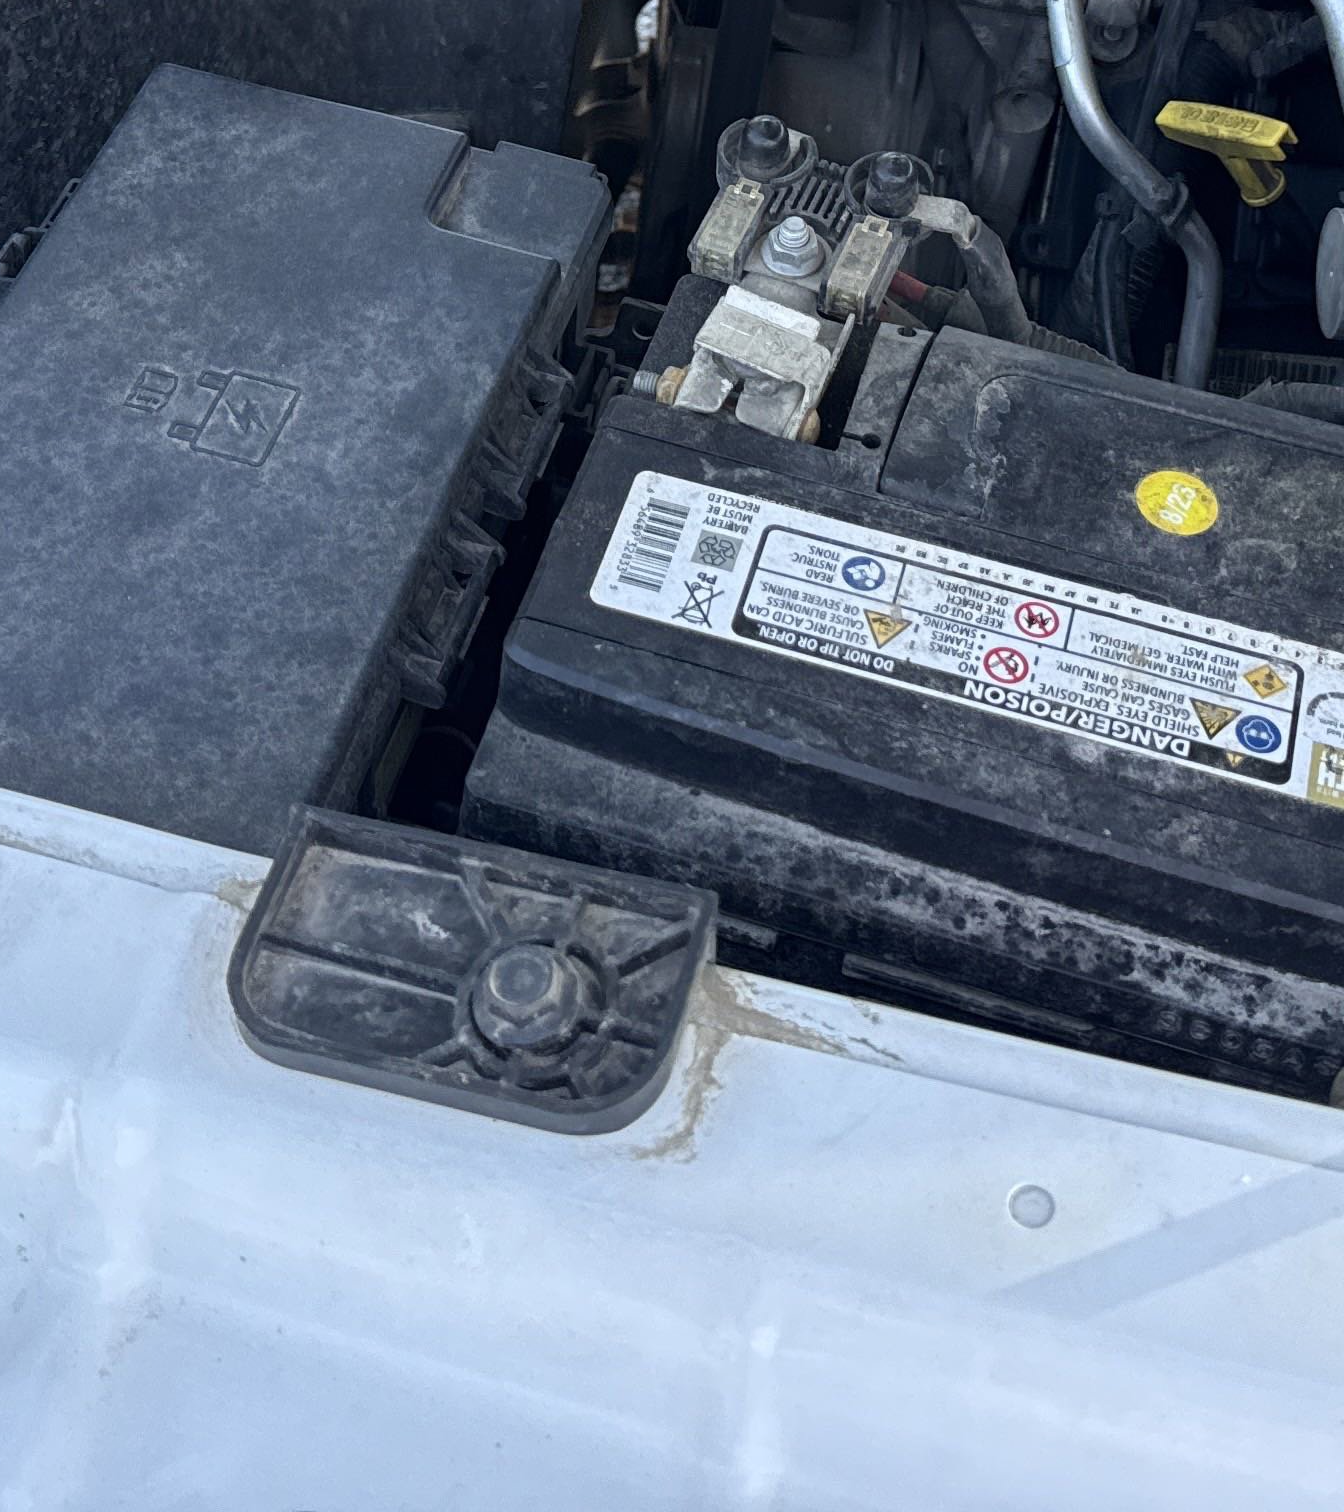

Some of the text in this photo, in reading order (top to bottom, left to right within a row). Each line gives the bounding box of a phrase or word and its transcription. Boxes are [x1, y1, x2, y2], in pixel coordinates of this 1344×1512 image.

[705, 490, 761, 514] RECYCLED
[705, 502, 754, 524] MUST BE
[629, 503, 651, 538] 56489
[701, 514, 750, 535] BATTERY
[615, 538, 637, 574] 32833
[804, 543, 842, 562] TIONS.
[694, 569, 719, 585] Pb
[803, 567, 835, 583] READ
[756, 580, 860, 616] OR SEVERE BURNS.
[931, 577, 1010, 607] OF CHILDREN.
[764, 595, 865, 630] CAUSE BLINDNESS
[931, 601, 1004, 629] KEEP OUT OF
[944, 592, 1007, 618] THE REACH
[744, 602, 868, 645] SULFURIC ACID CAN
[921, 614, 978, 638] SMOKING
[753, 623, 896, 672] DO NOT TIP OR OPEN.
[927, 640, 972, 661] SPARKS
[930, 629, 975, 650] FLAMES
[1086, 630, 1138, 654] MEDICAL
[1139, 644, 1162, 660] GET
[1210, 651, 1240, 669] HELP
[956, 660, 979, 676] NO
[1089, 644, 1236, 692] FLUSH EYES IMMEDIATELY
[1201, 660, 1238, 680] WITH
[1053, 659, 1185, 705] BLINDNESS OR INJURY.
[1036, 681, 1110, 712] EXPLOSIVE
[1080, 680, 1191, 720] GASES CAN CAUSE
[961, 678, 1192, 758] DANGER/POISON
[1150, 713, 1200, 737] SHIELD
